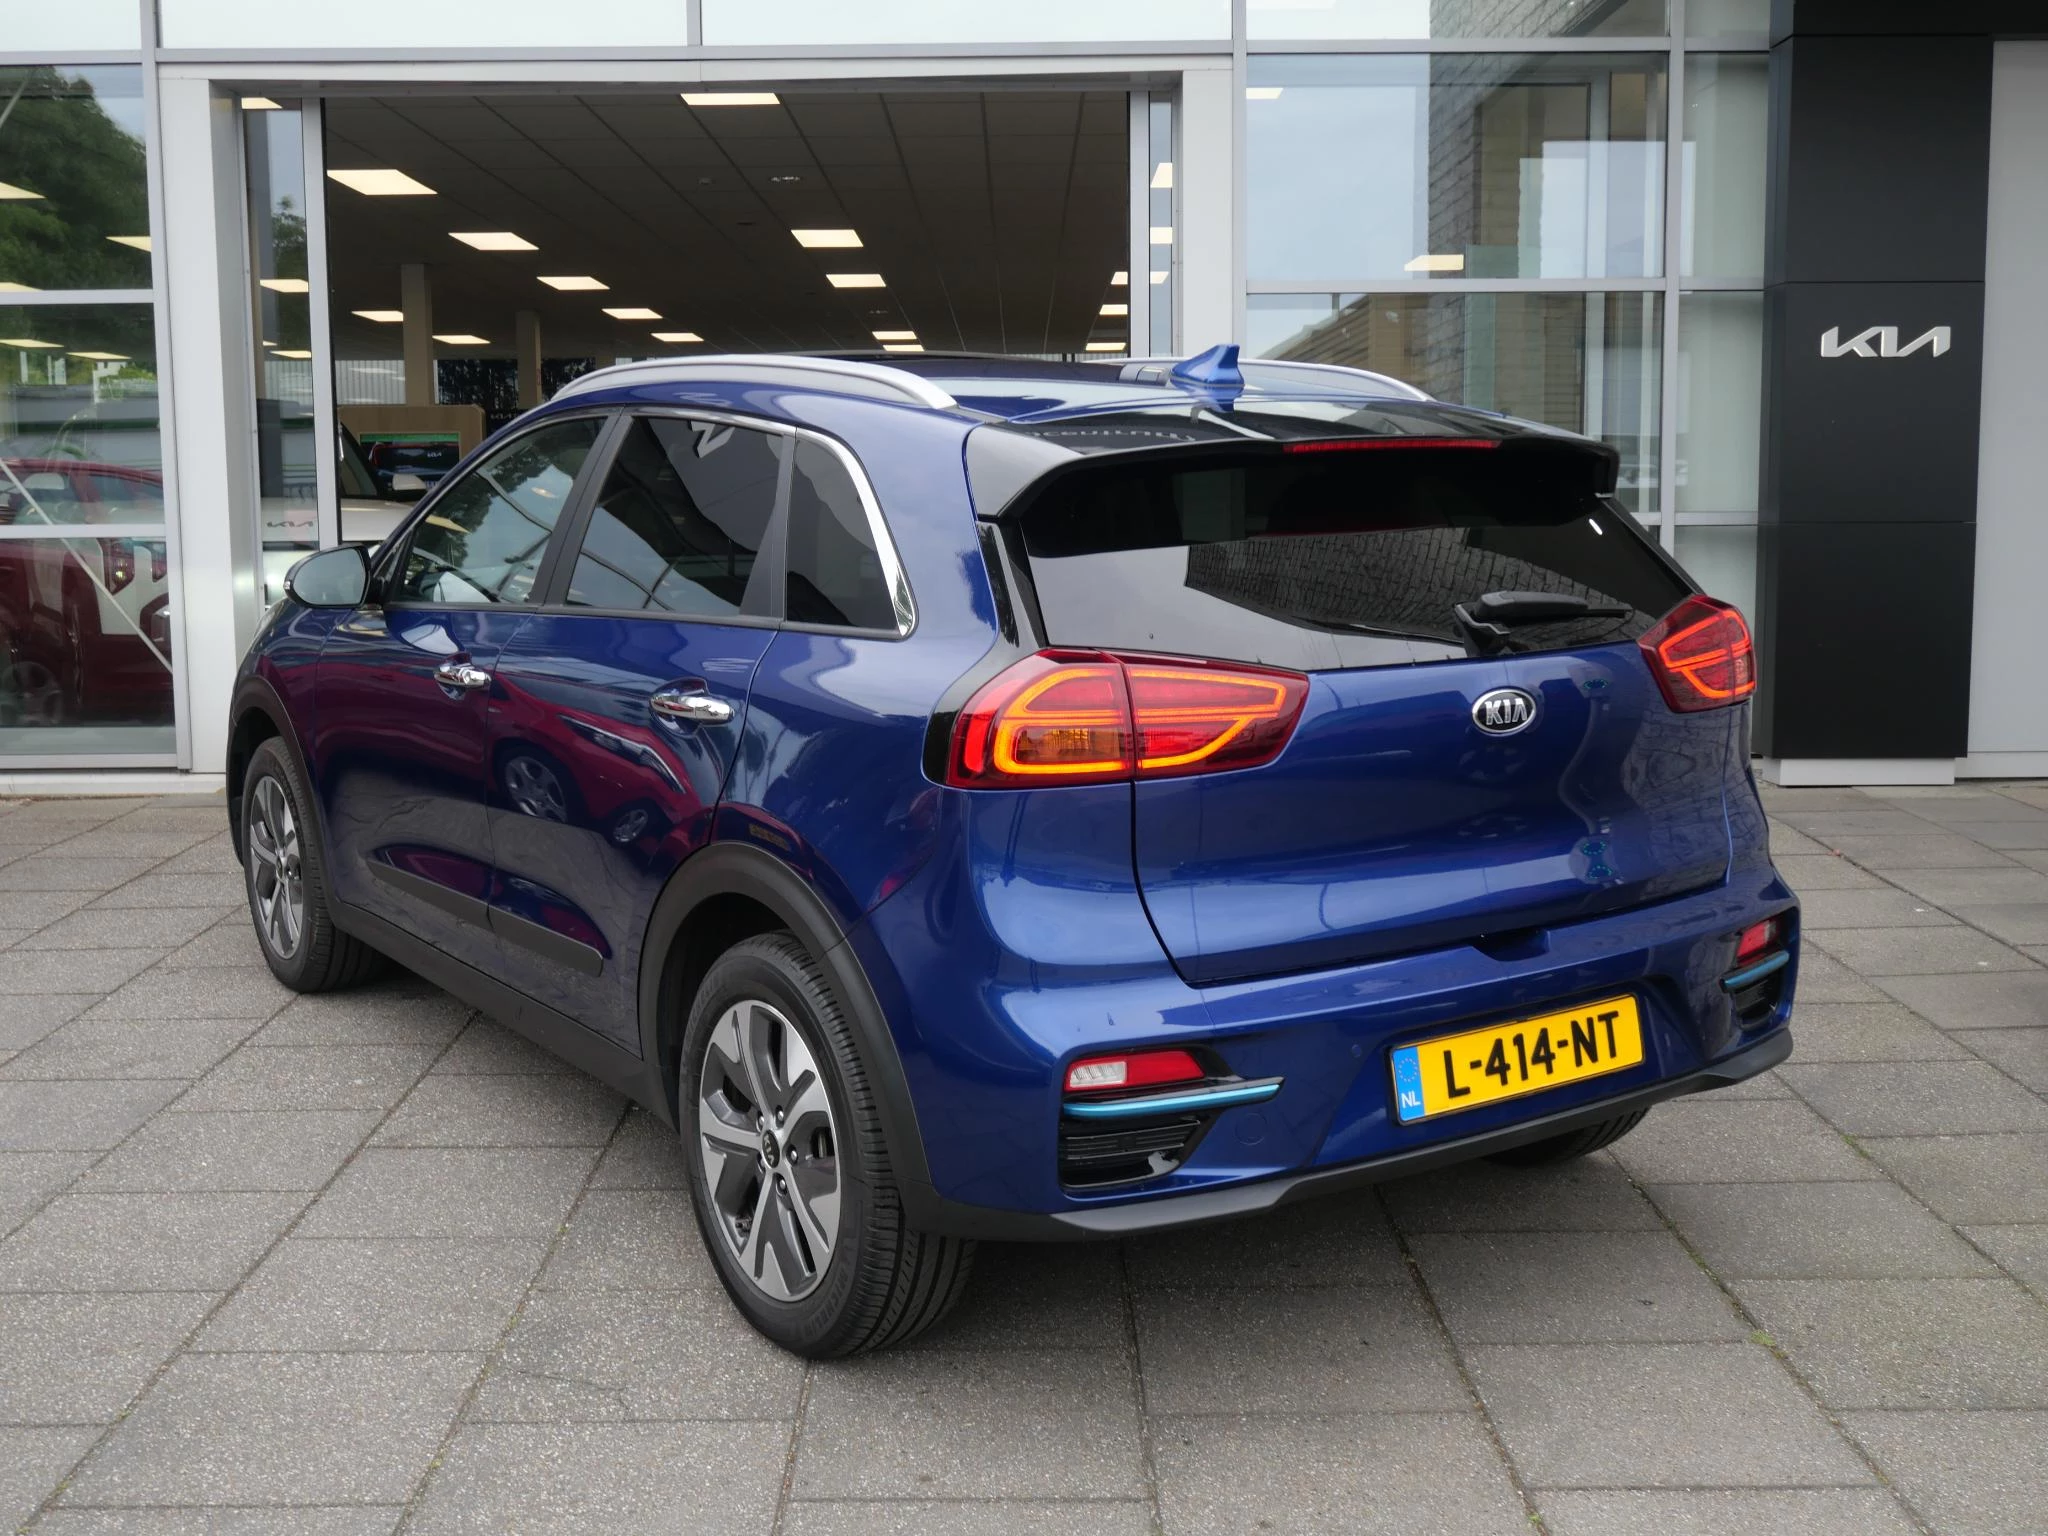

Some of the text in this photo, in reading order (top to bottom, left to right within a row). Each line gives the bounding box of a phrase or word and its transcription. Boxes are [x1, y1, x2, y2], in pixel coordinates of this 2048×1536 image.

[1820, 326, 1951, 358] KIA
[1484, 697, 1528, 725] KIA
[1443, 1010, 1619, 1099] L-414-NT
[1400, 1090, 1421, 1108] NL
[763, 1134, 775, 1165] KIA
